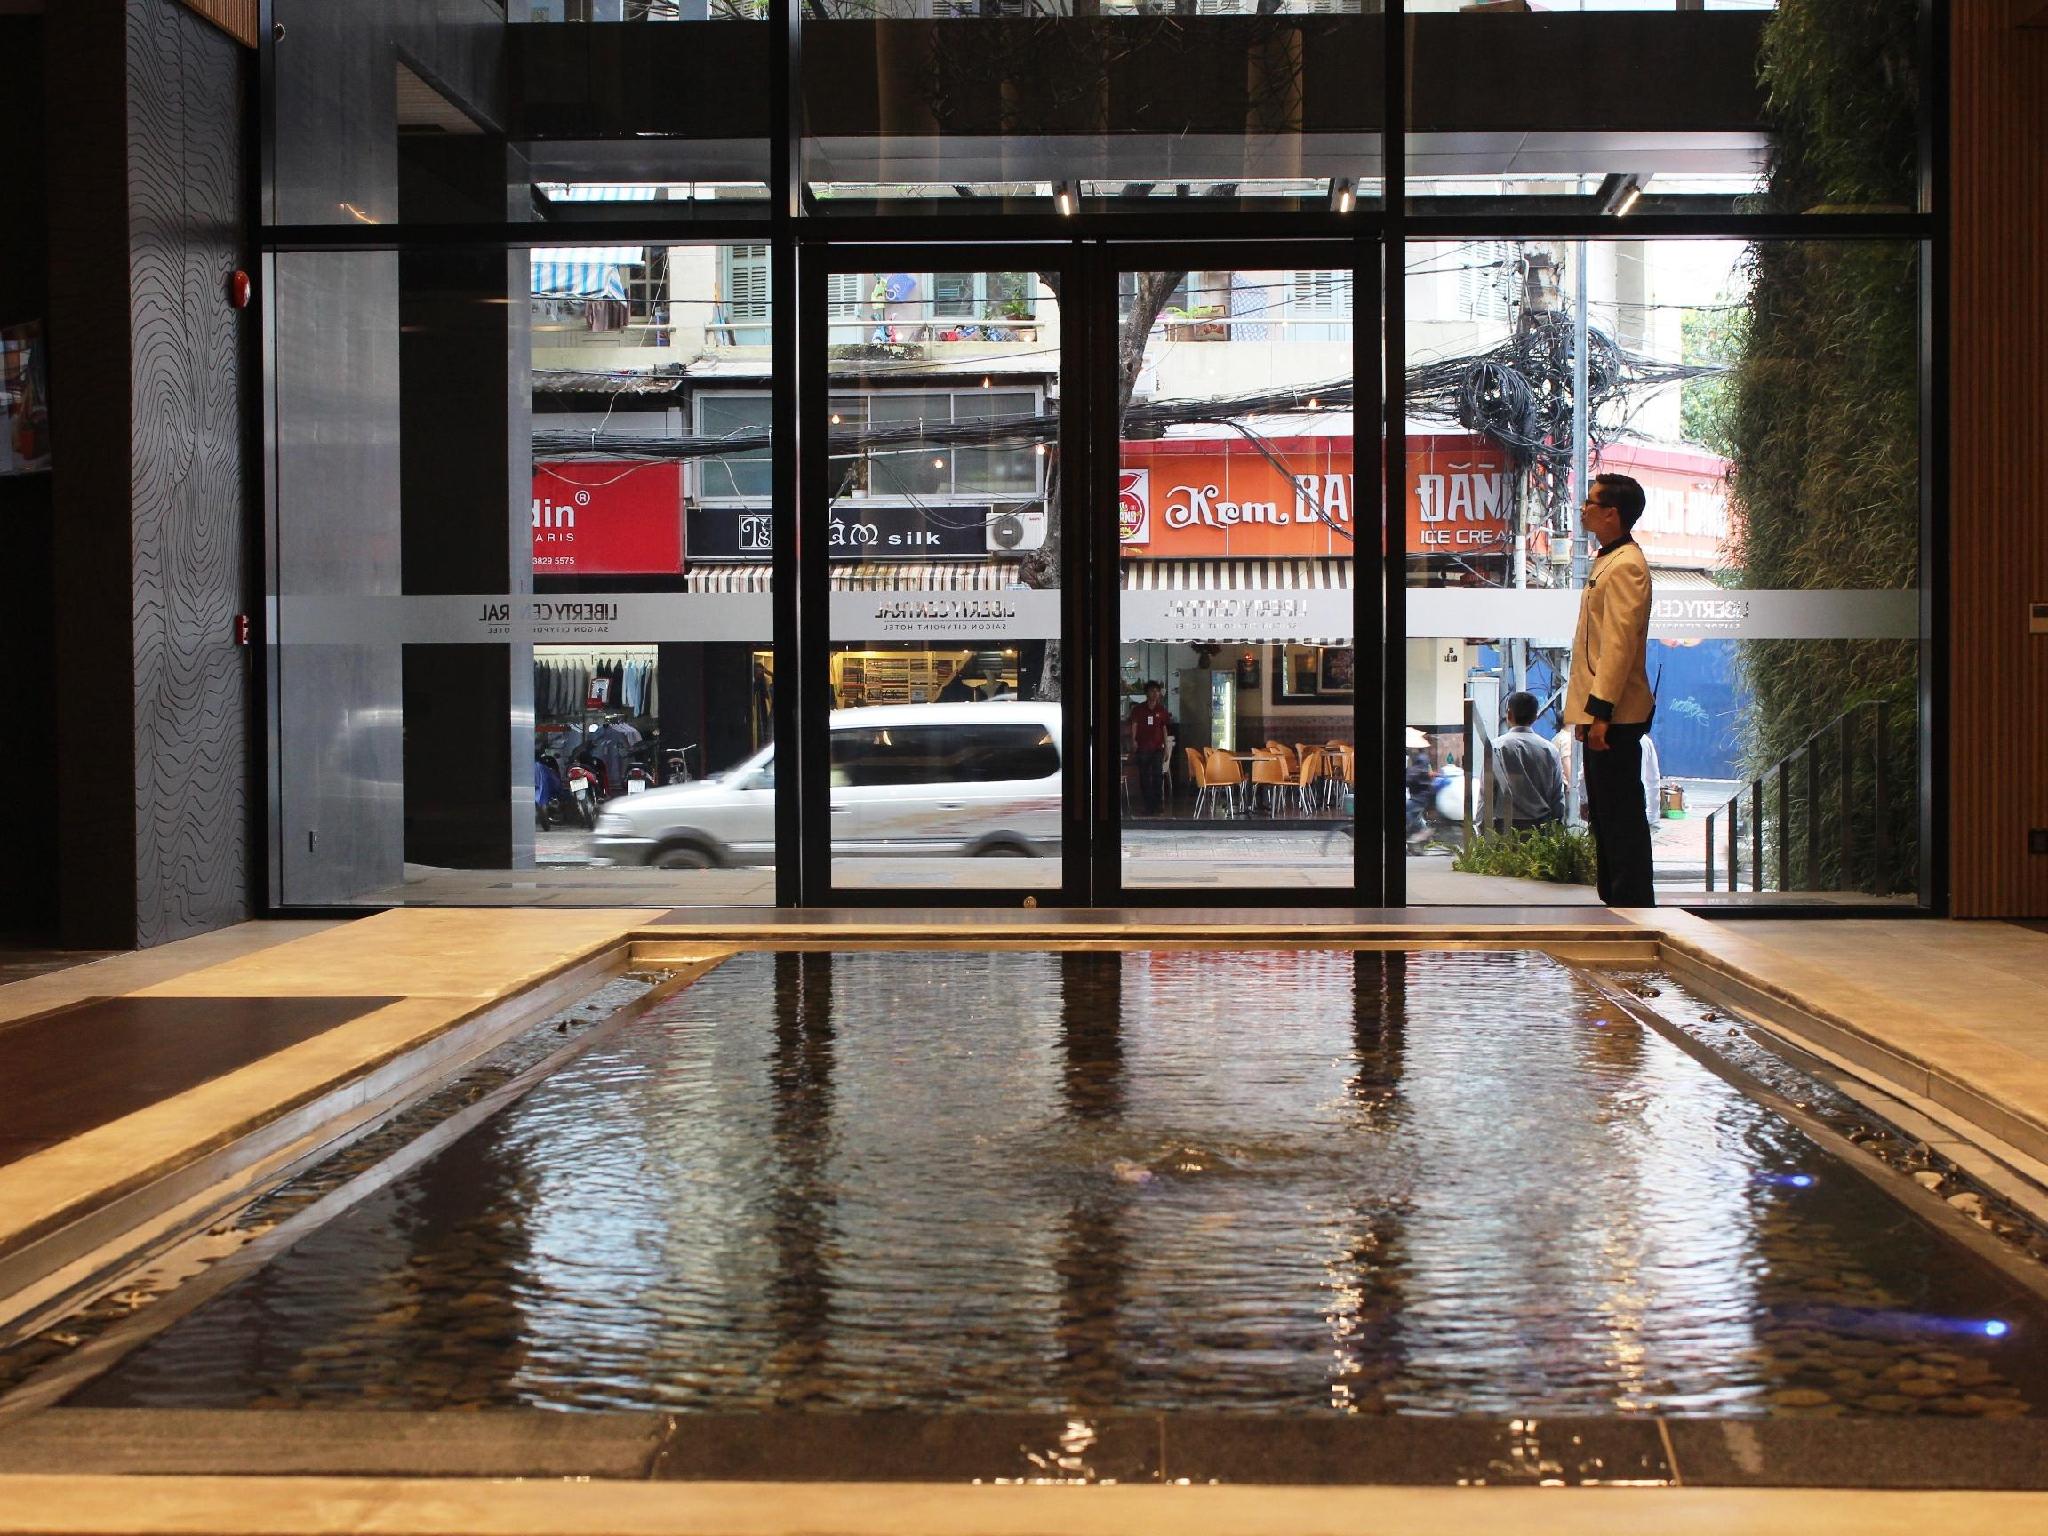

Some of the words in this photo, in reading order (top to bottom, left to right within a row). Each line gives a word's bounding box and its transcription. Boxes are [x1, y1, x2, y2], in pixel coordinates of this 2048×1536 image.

[1164, 484, 1290, 529] Kem
[1295, 474, 1354, 523] BA
[531, 498, 575, 528] din
[535, 532, 574, 542] ARIS
[888, 531, 941, 545] silk
[1420, 529, 1450, 544] ICE
[532, 556, 552, 565] 3829
[554, 556, 575, 565] 5575
